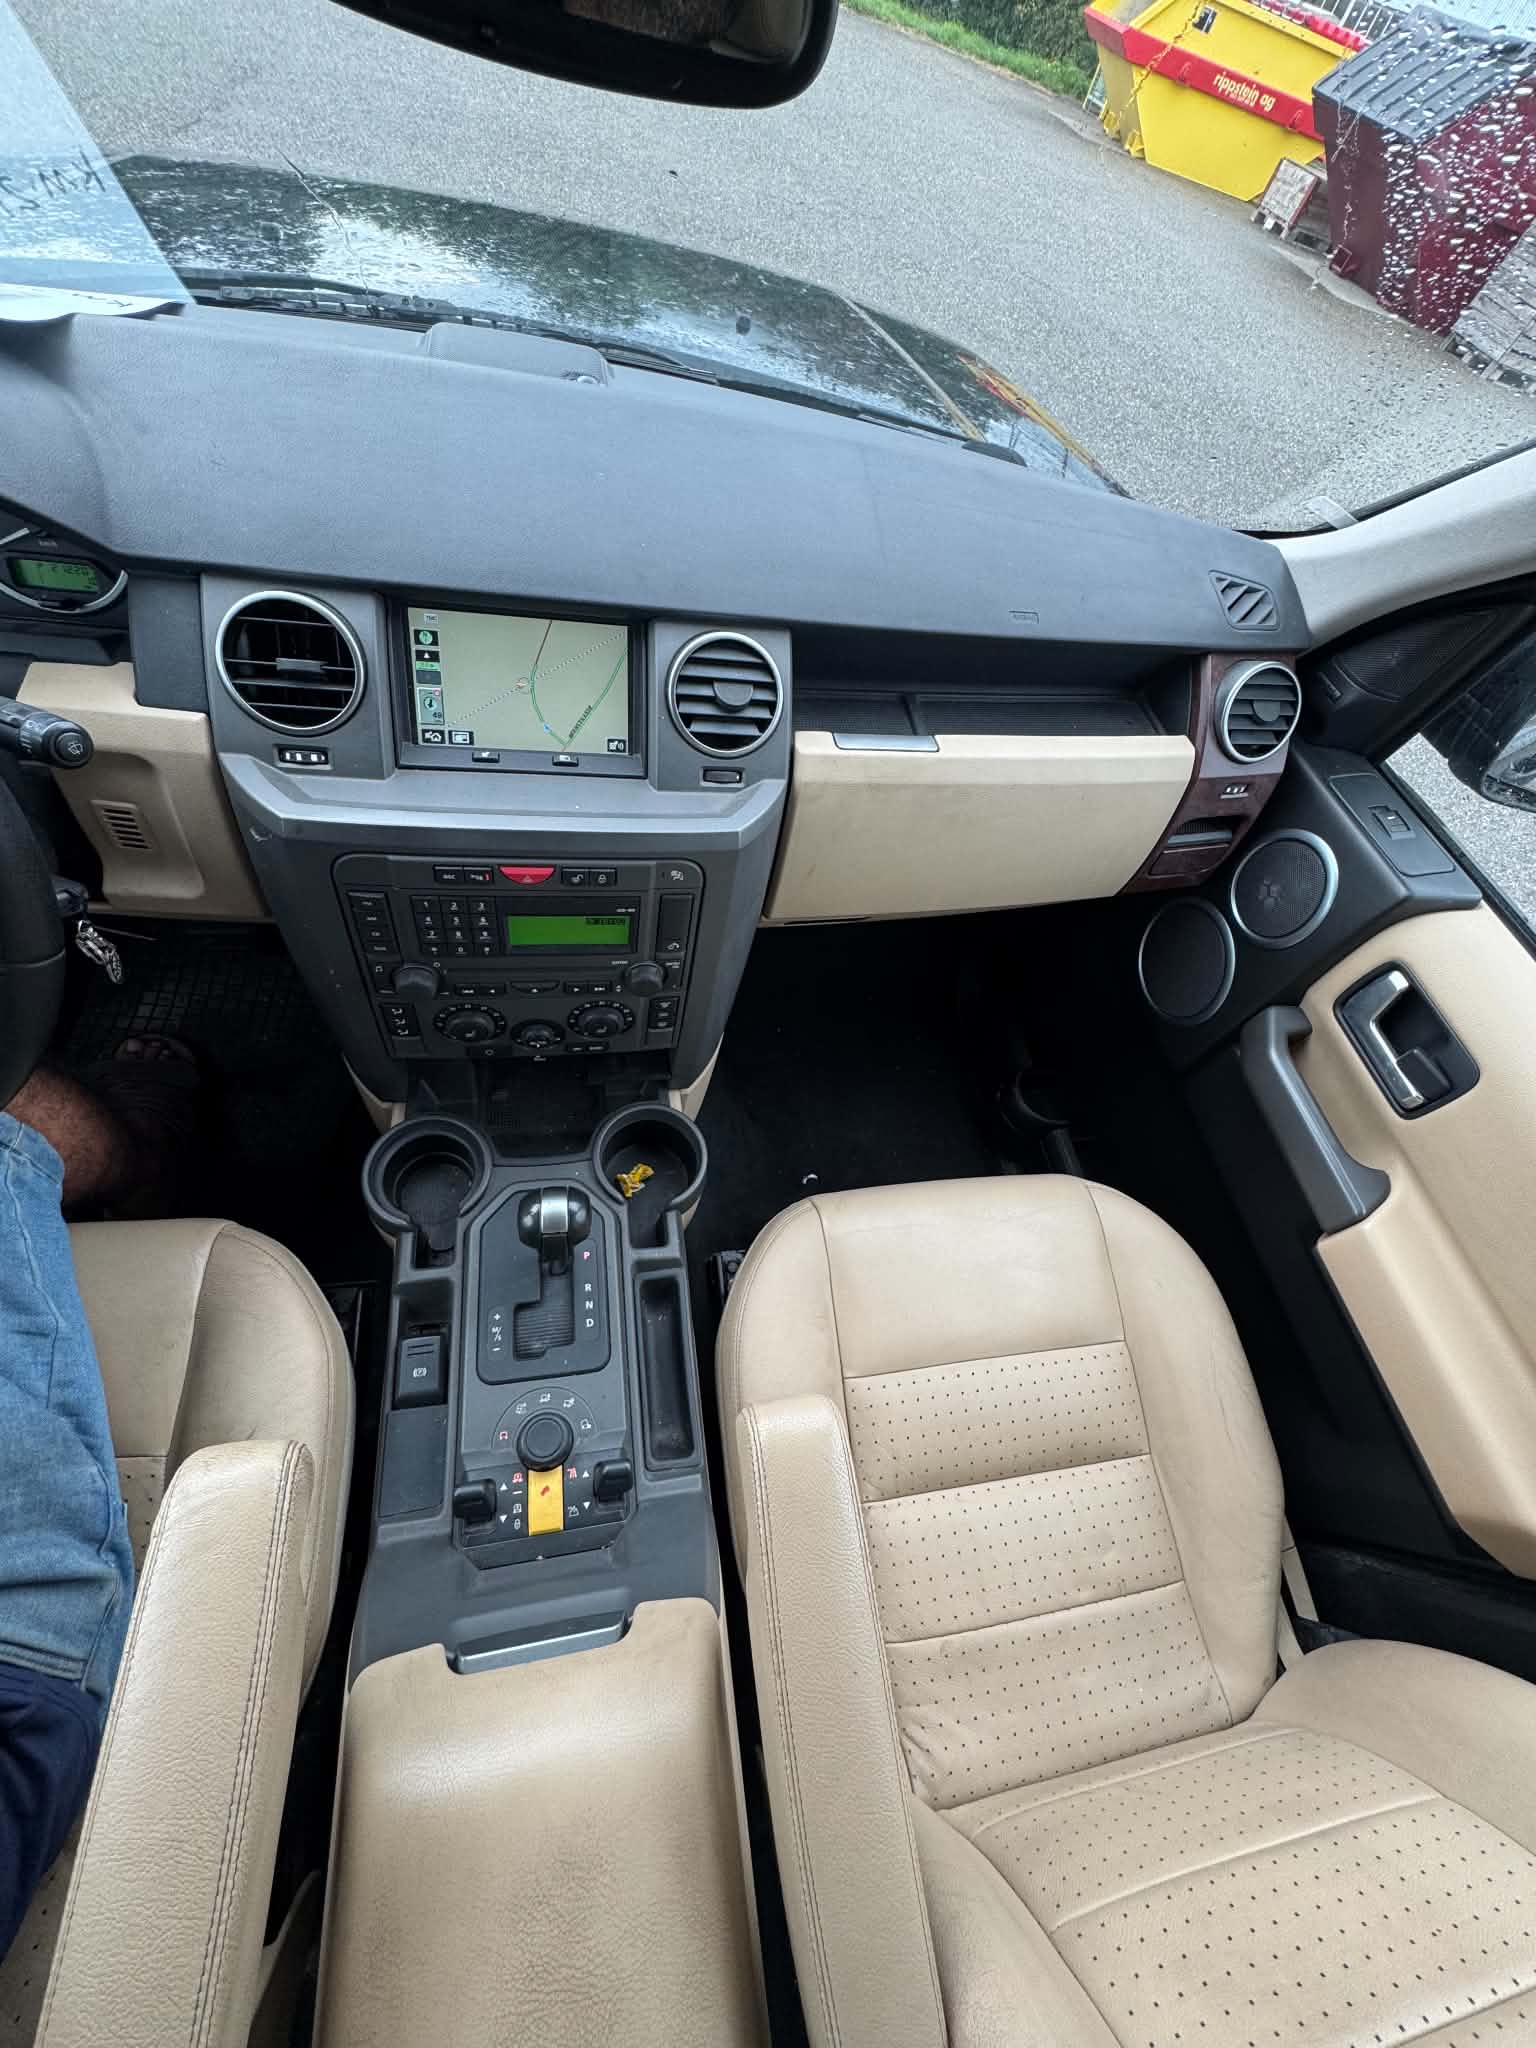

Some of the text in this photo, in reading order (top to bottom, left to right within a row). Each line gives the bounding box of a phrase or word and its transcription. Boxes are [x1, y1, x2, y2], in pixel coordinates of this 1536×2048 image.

[1259, 93, 1277, 111] ag
[584, 1251, 591, 1260] P
[585, 1283, 592, 1292] R
[586, 1301, 593, 1310] N
[586, 1318, 594, 1328] D
